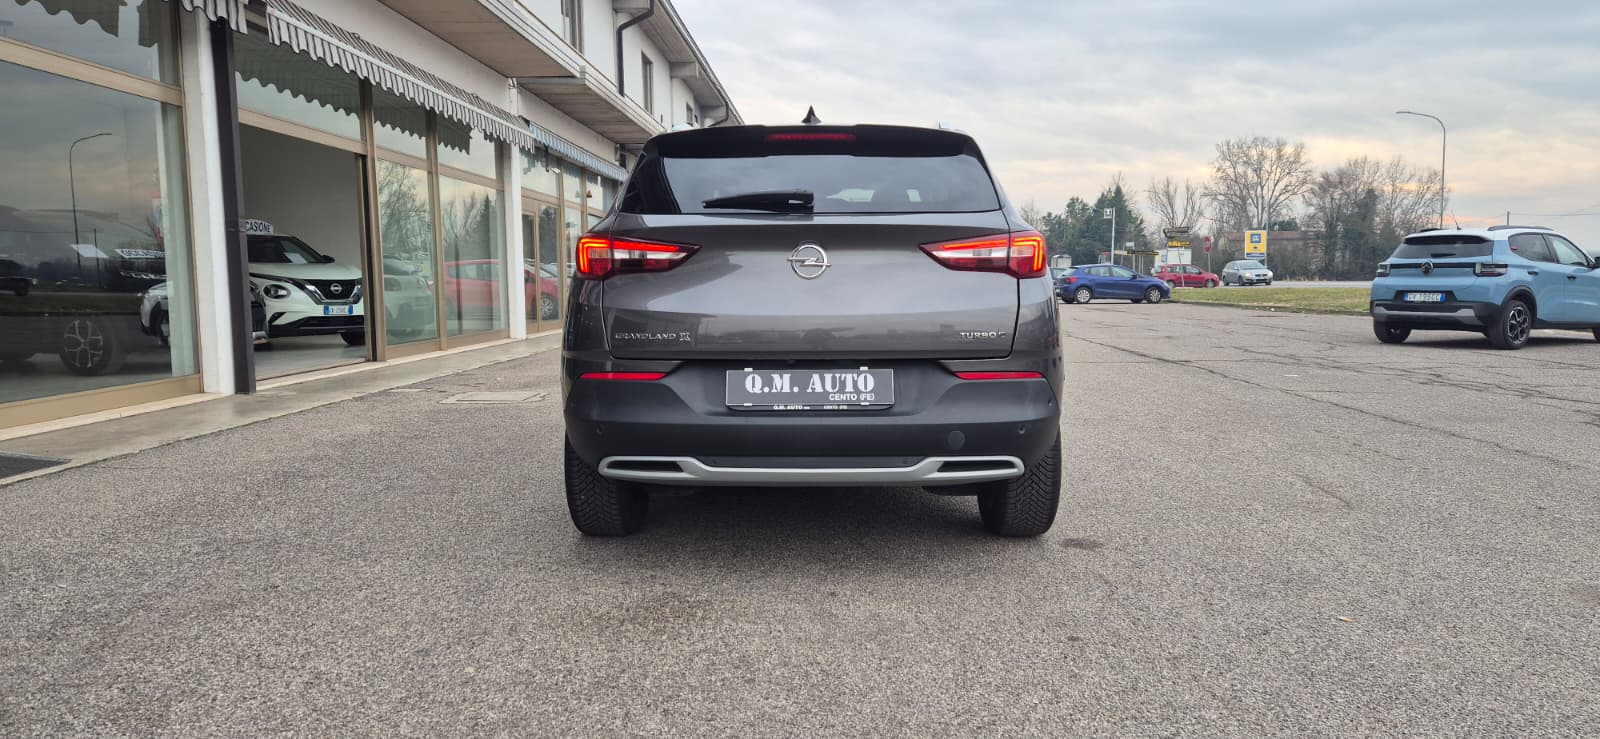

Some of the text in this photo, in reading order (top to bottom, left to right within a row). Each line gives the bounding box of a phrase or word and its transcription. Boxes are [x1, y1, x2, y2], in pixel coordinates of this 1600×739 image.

[245, 220, 271, 232] CASIONE
[959, 331, 997, 339] TURBO
[745, 373, 875, 393] Q.M. AUTO
[829, 393, 875, 401] CENTO (FE)
